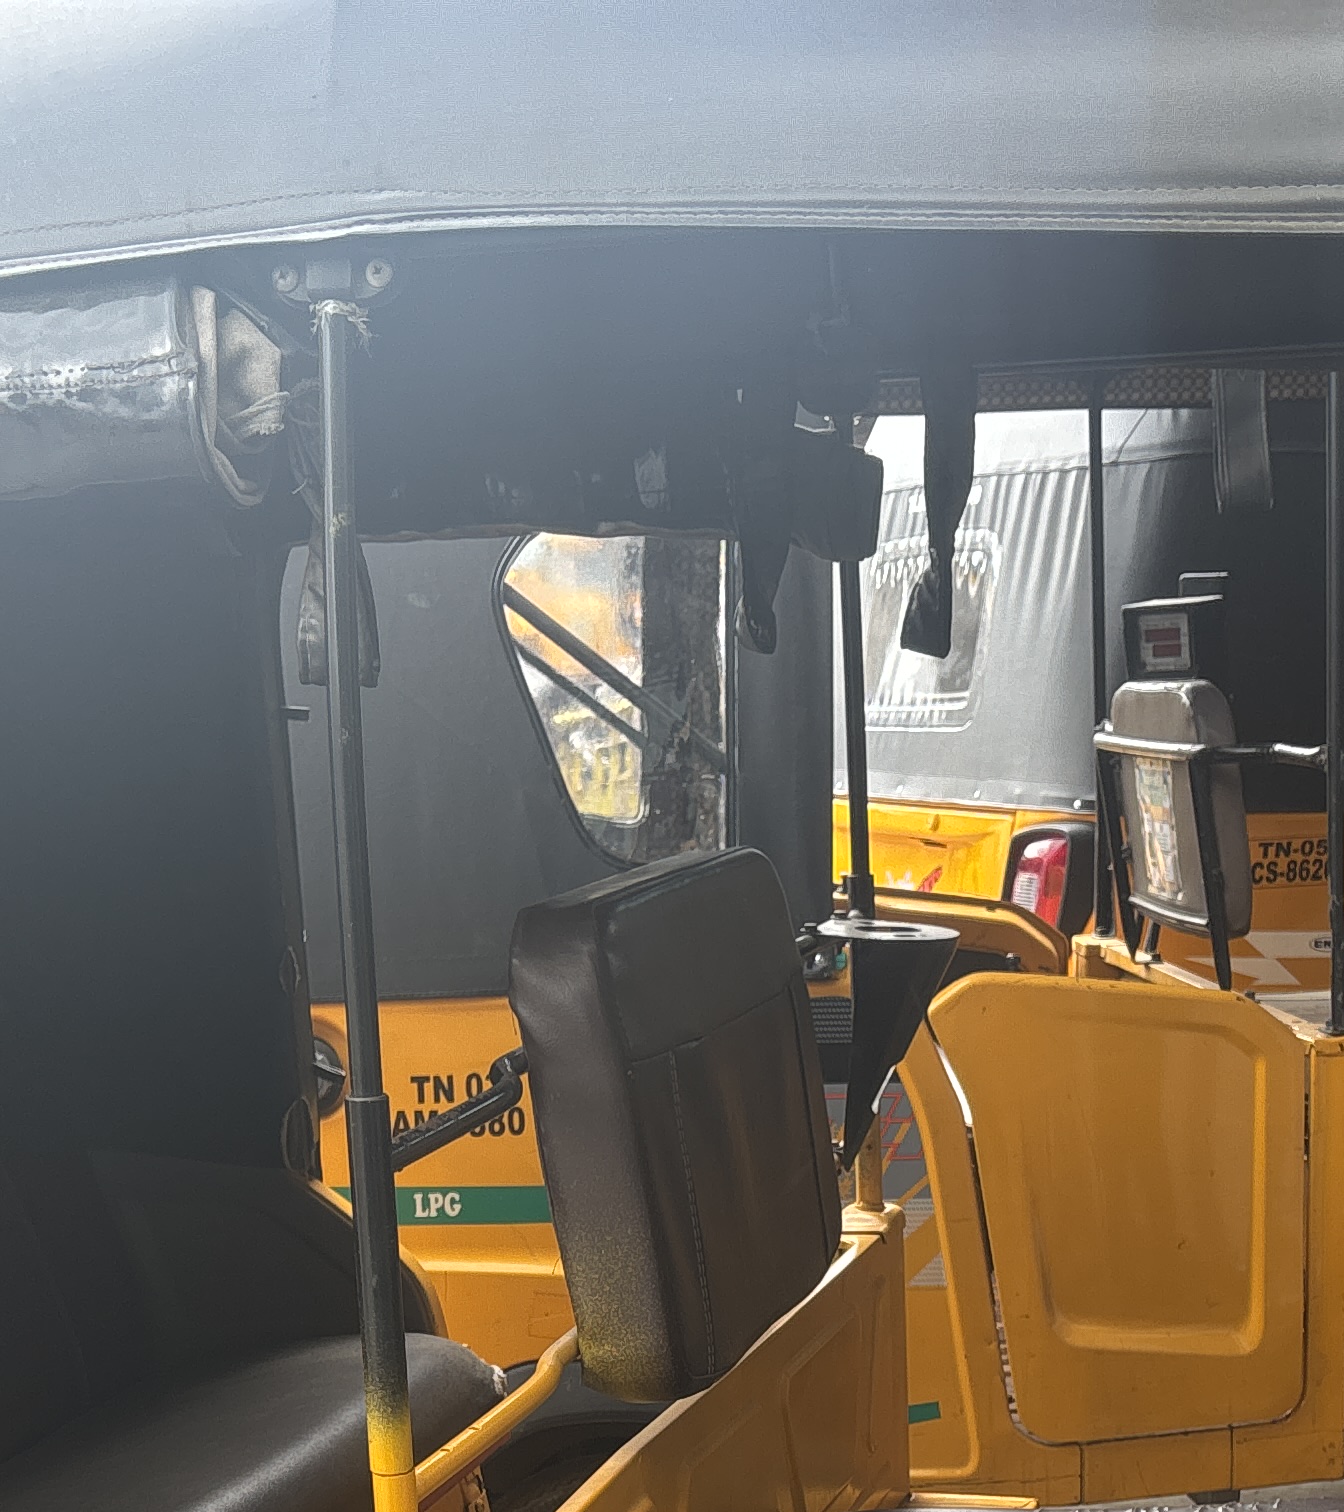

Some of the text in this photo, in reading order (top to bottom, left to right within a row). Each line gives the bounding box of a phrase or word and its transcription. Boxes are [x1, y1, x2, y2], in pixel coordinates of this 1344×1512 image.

[1251, 858, 1329, 884] CS-862
[410, 1074, 455, 1104] TN
[413, 1192, 463, 1218] LPG
